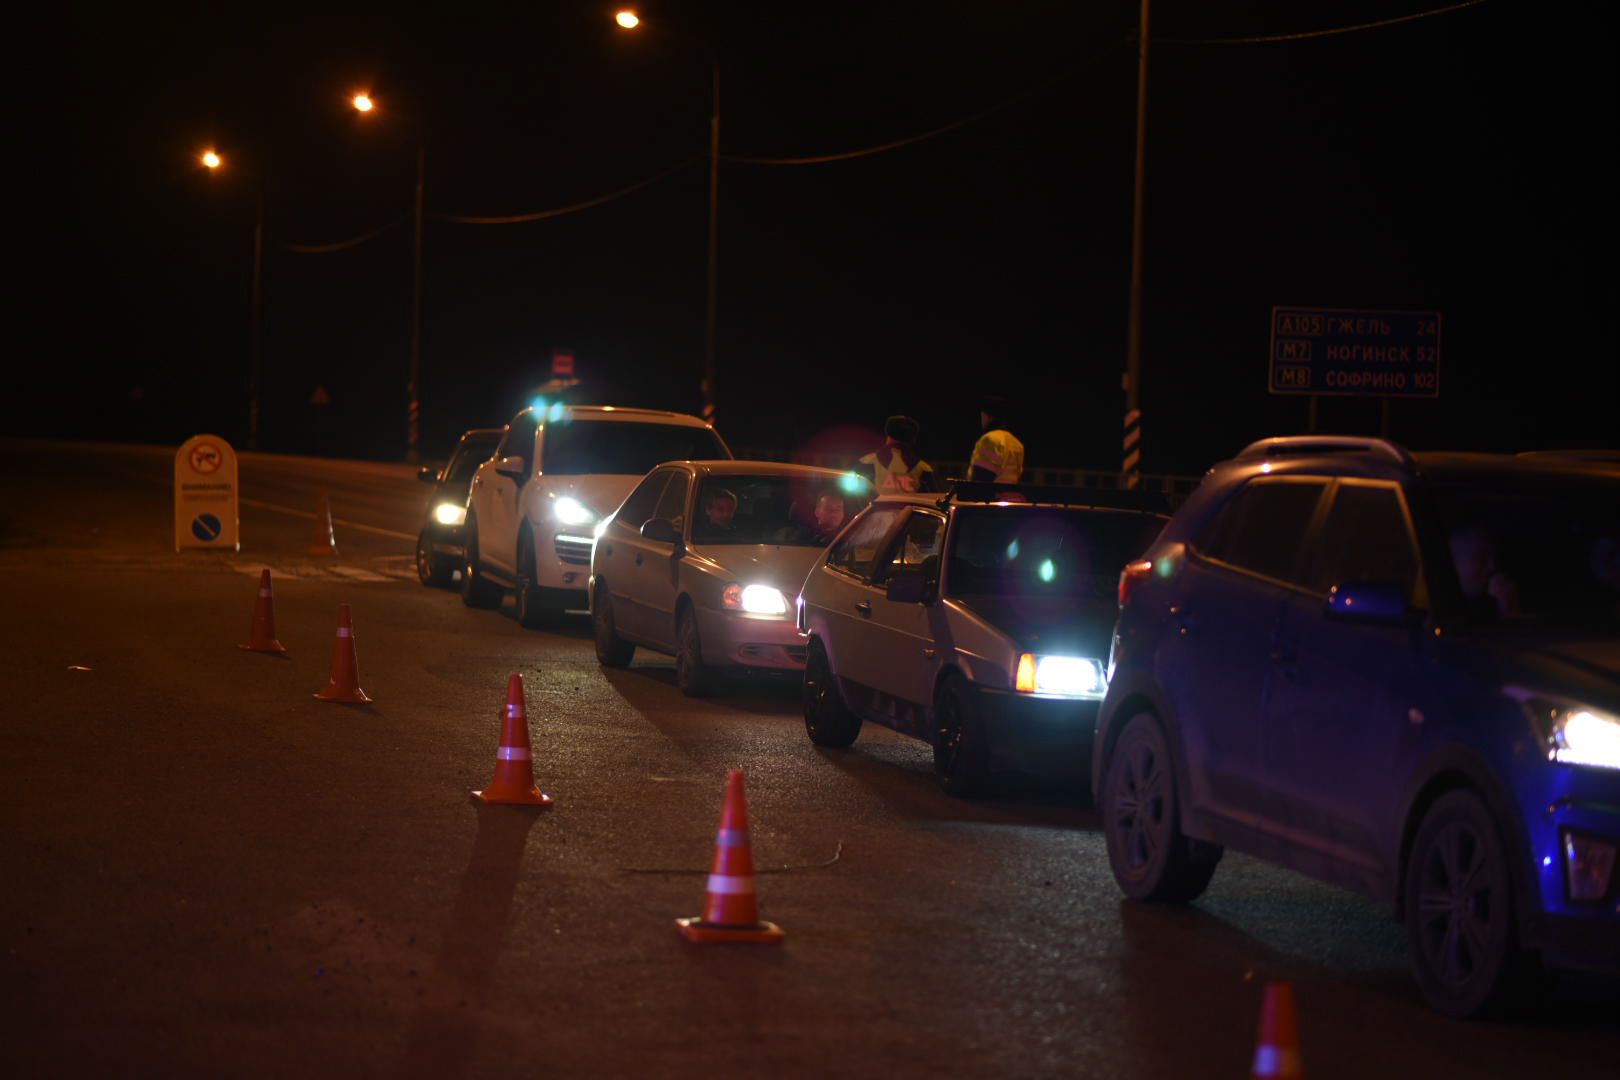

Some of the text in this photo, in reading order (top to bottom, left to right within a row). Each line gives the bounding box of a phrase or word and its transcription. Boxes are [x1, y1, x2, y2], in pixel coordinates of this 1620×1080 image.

[1327, 317, 1391, 336] ГЖЕЛЬ
[1416, 319, 1436, 336] 24
[1327, 344, 1409, 361] НОГИНСК
[1416, 345, 1435, 362] 52
[1326, 370, 1407, 388] СОФРИНО
[1414, 371, 1436, 388] 102
